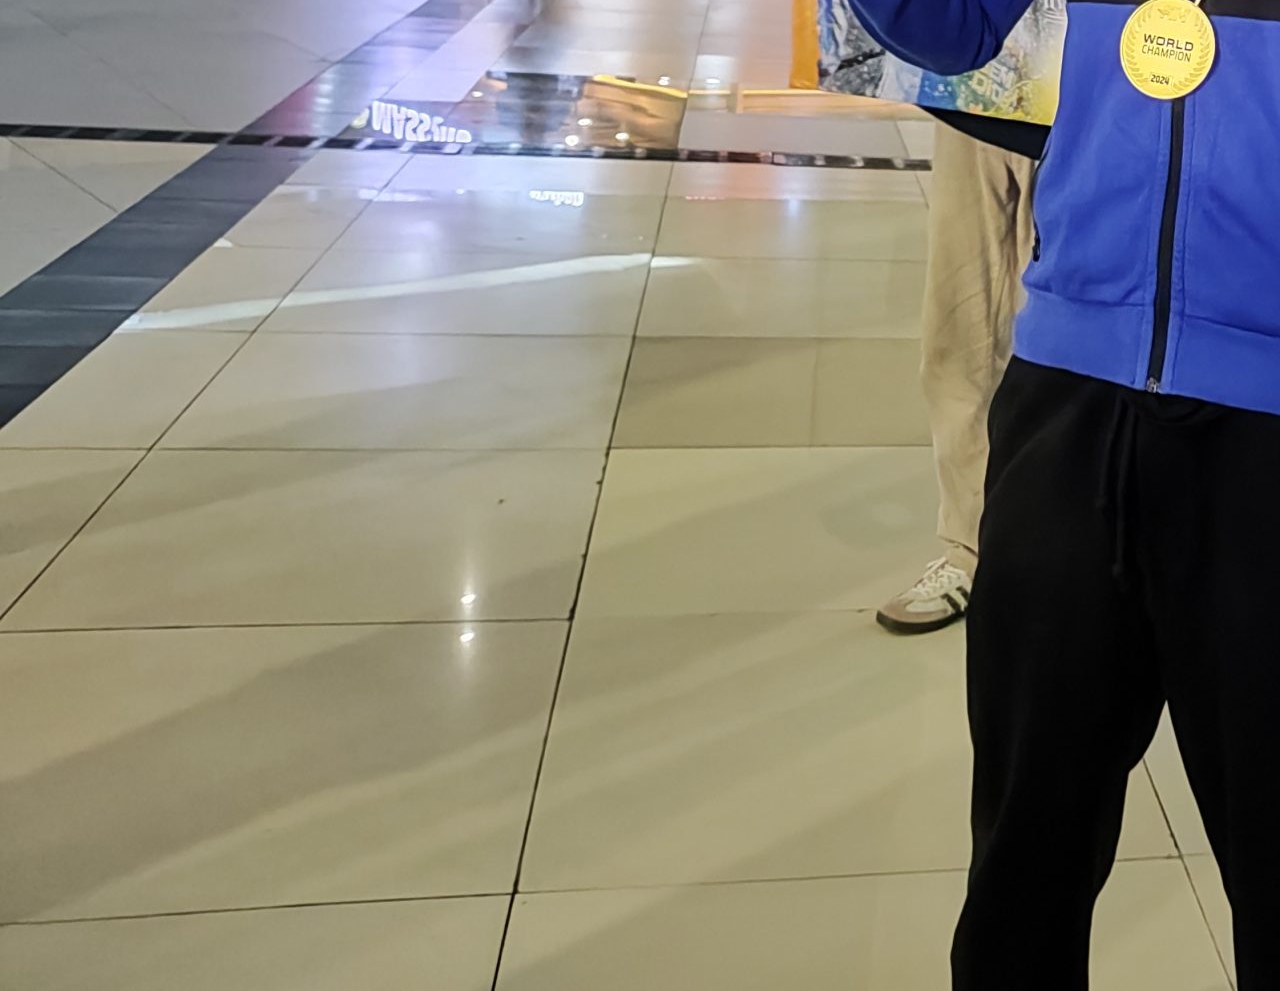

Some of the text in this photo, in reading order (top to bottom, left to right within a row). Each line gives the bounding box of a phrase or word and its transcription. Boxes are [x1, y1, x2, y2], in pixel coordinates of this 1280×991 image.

[1143, 33, 1194, 52] WORLD
[1141, 44, 1192, 62] CHAMPION
[1150, 74, 1170, 85] 2024
